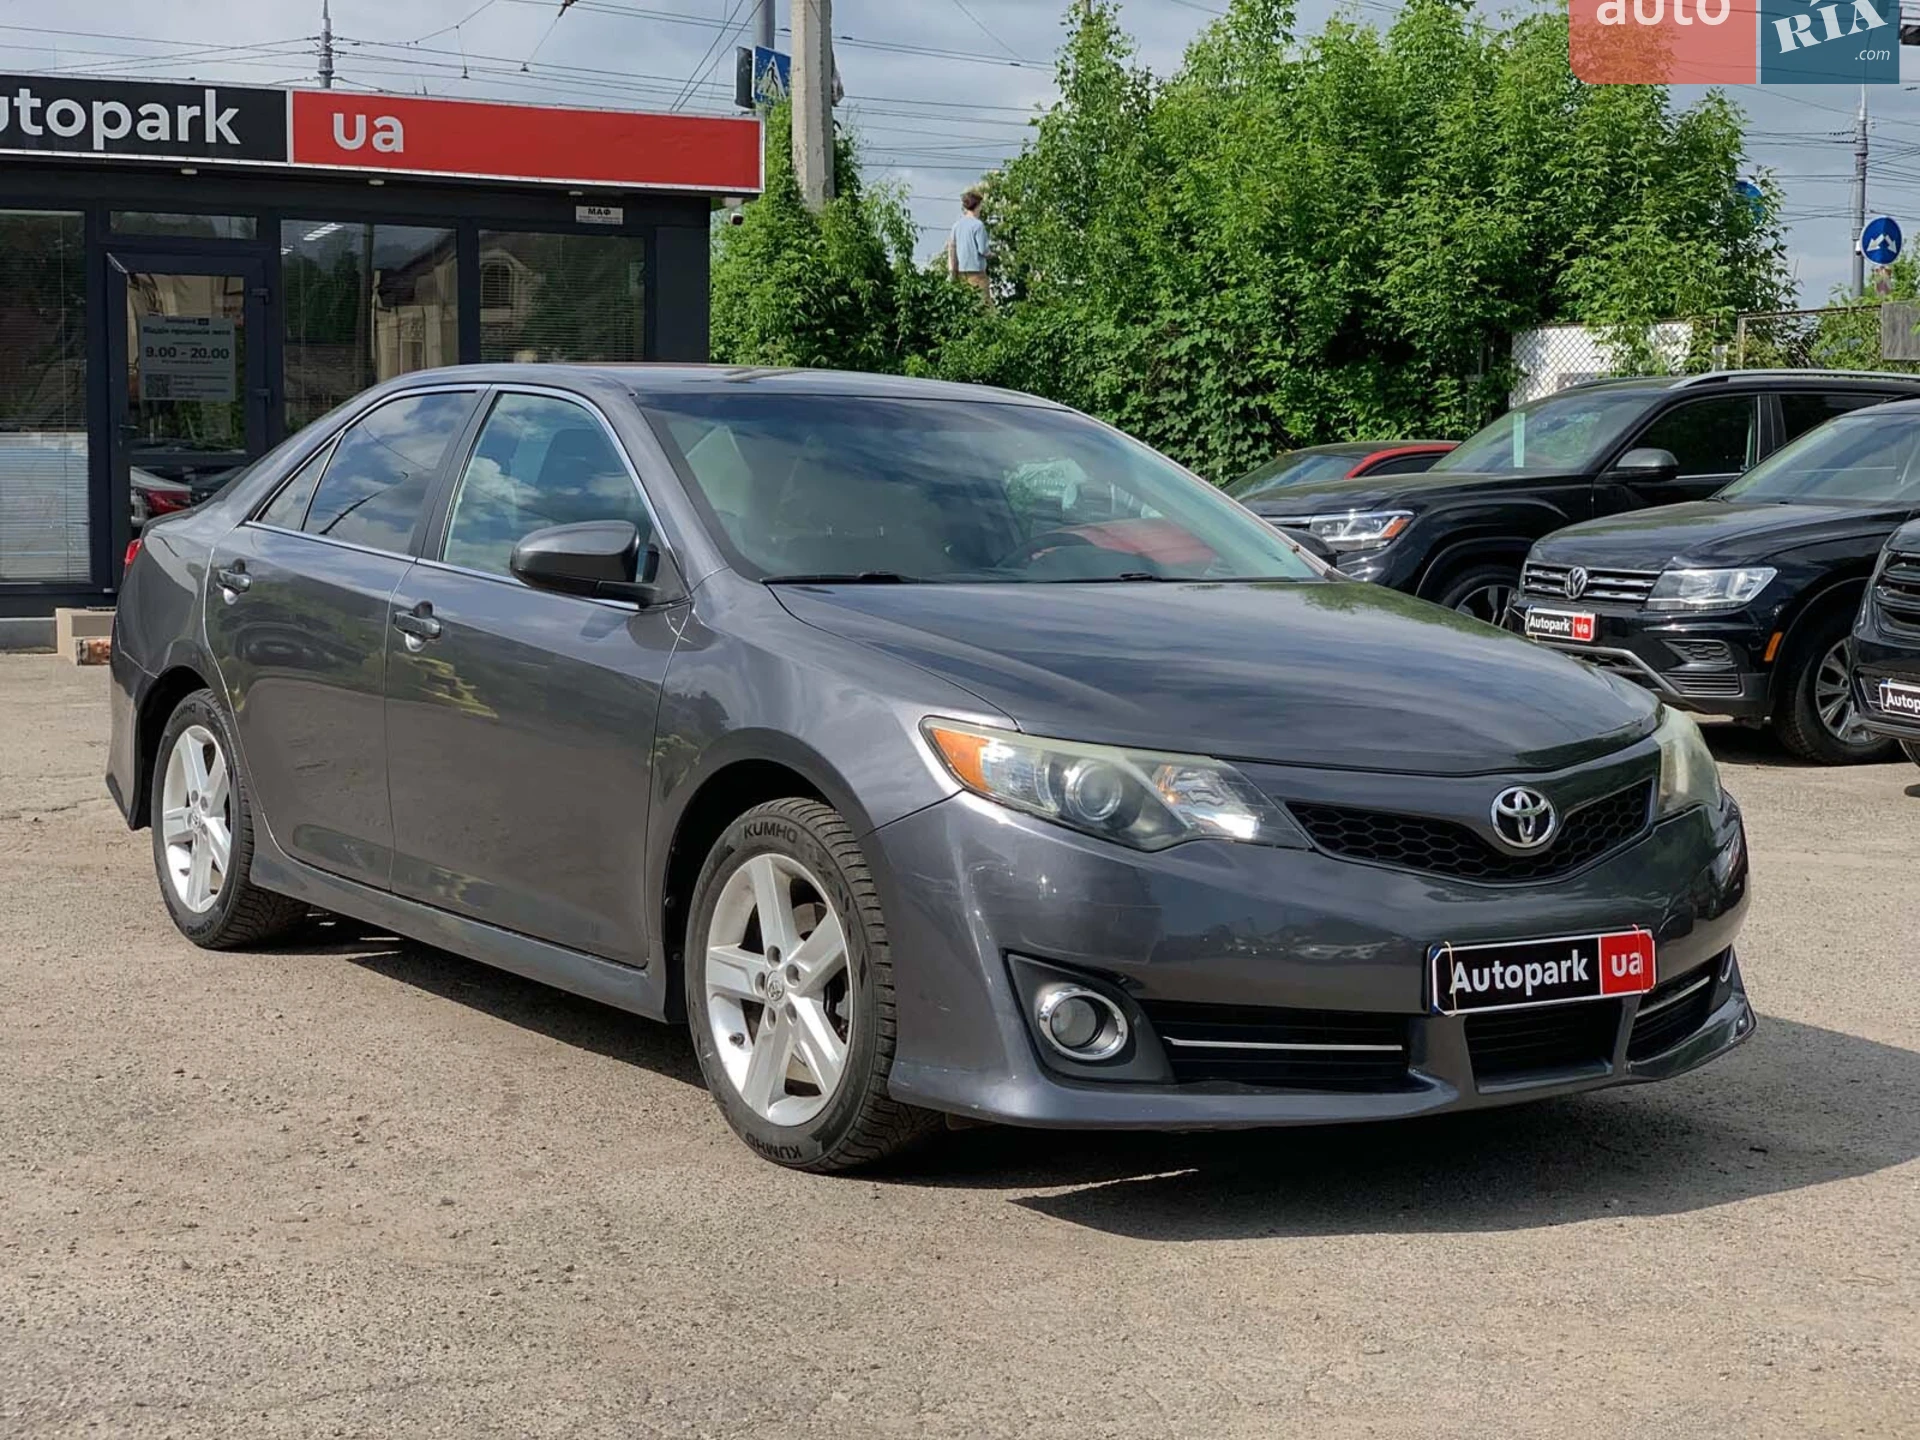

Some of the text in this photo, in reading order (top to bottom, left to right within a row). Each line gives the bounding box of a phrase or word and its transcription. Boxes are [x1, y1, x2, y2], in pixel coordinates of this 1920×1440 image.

[0, 88, 404, 153] topark ua
[587, 207, 612, 216] МАФ
[146, 346, 177, 358] 9.00
[191, 347, 230, 360] 20.00
[1529, 614, 1589, 633] Autopark ua
[743, 821, 798, 844] KUMHO
[1451, 949, 1644, 997] Autopark ua
